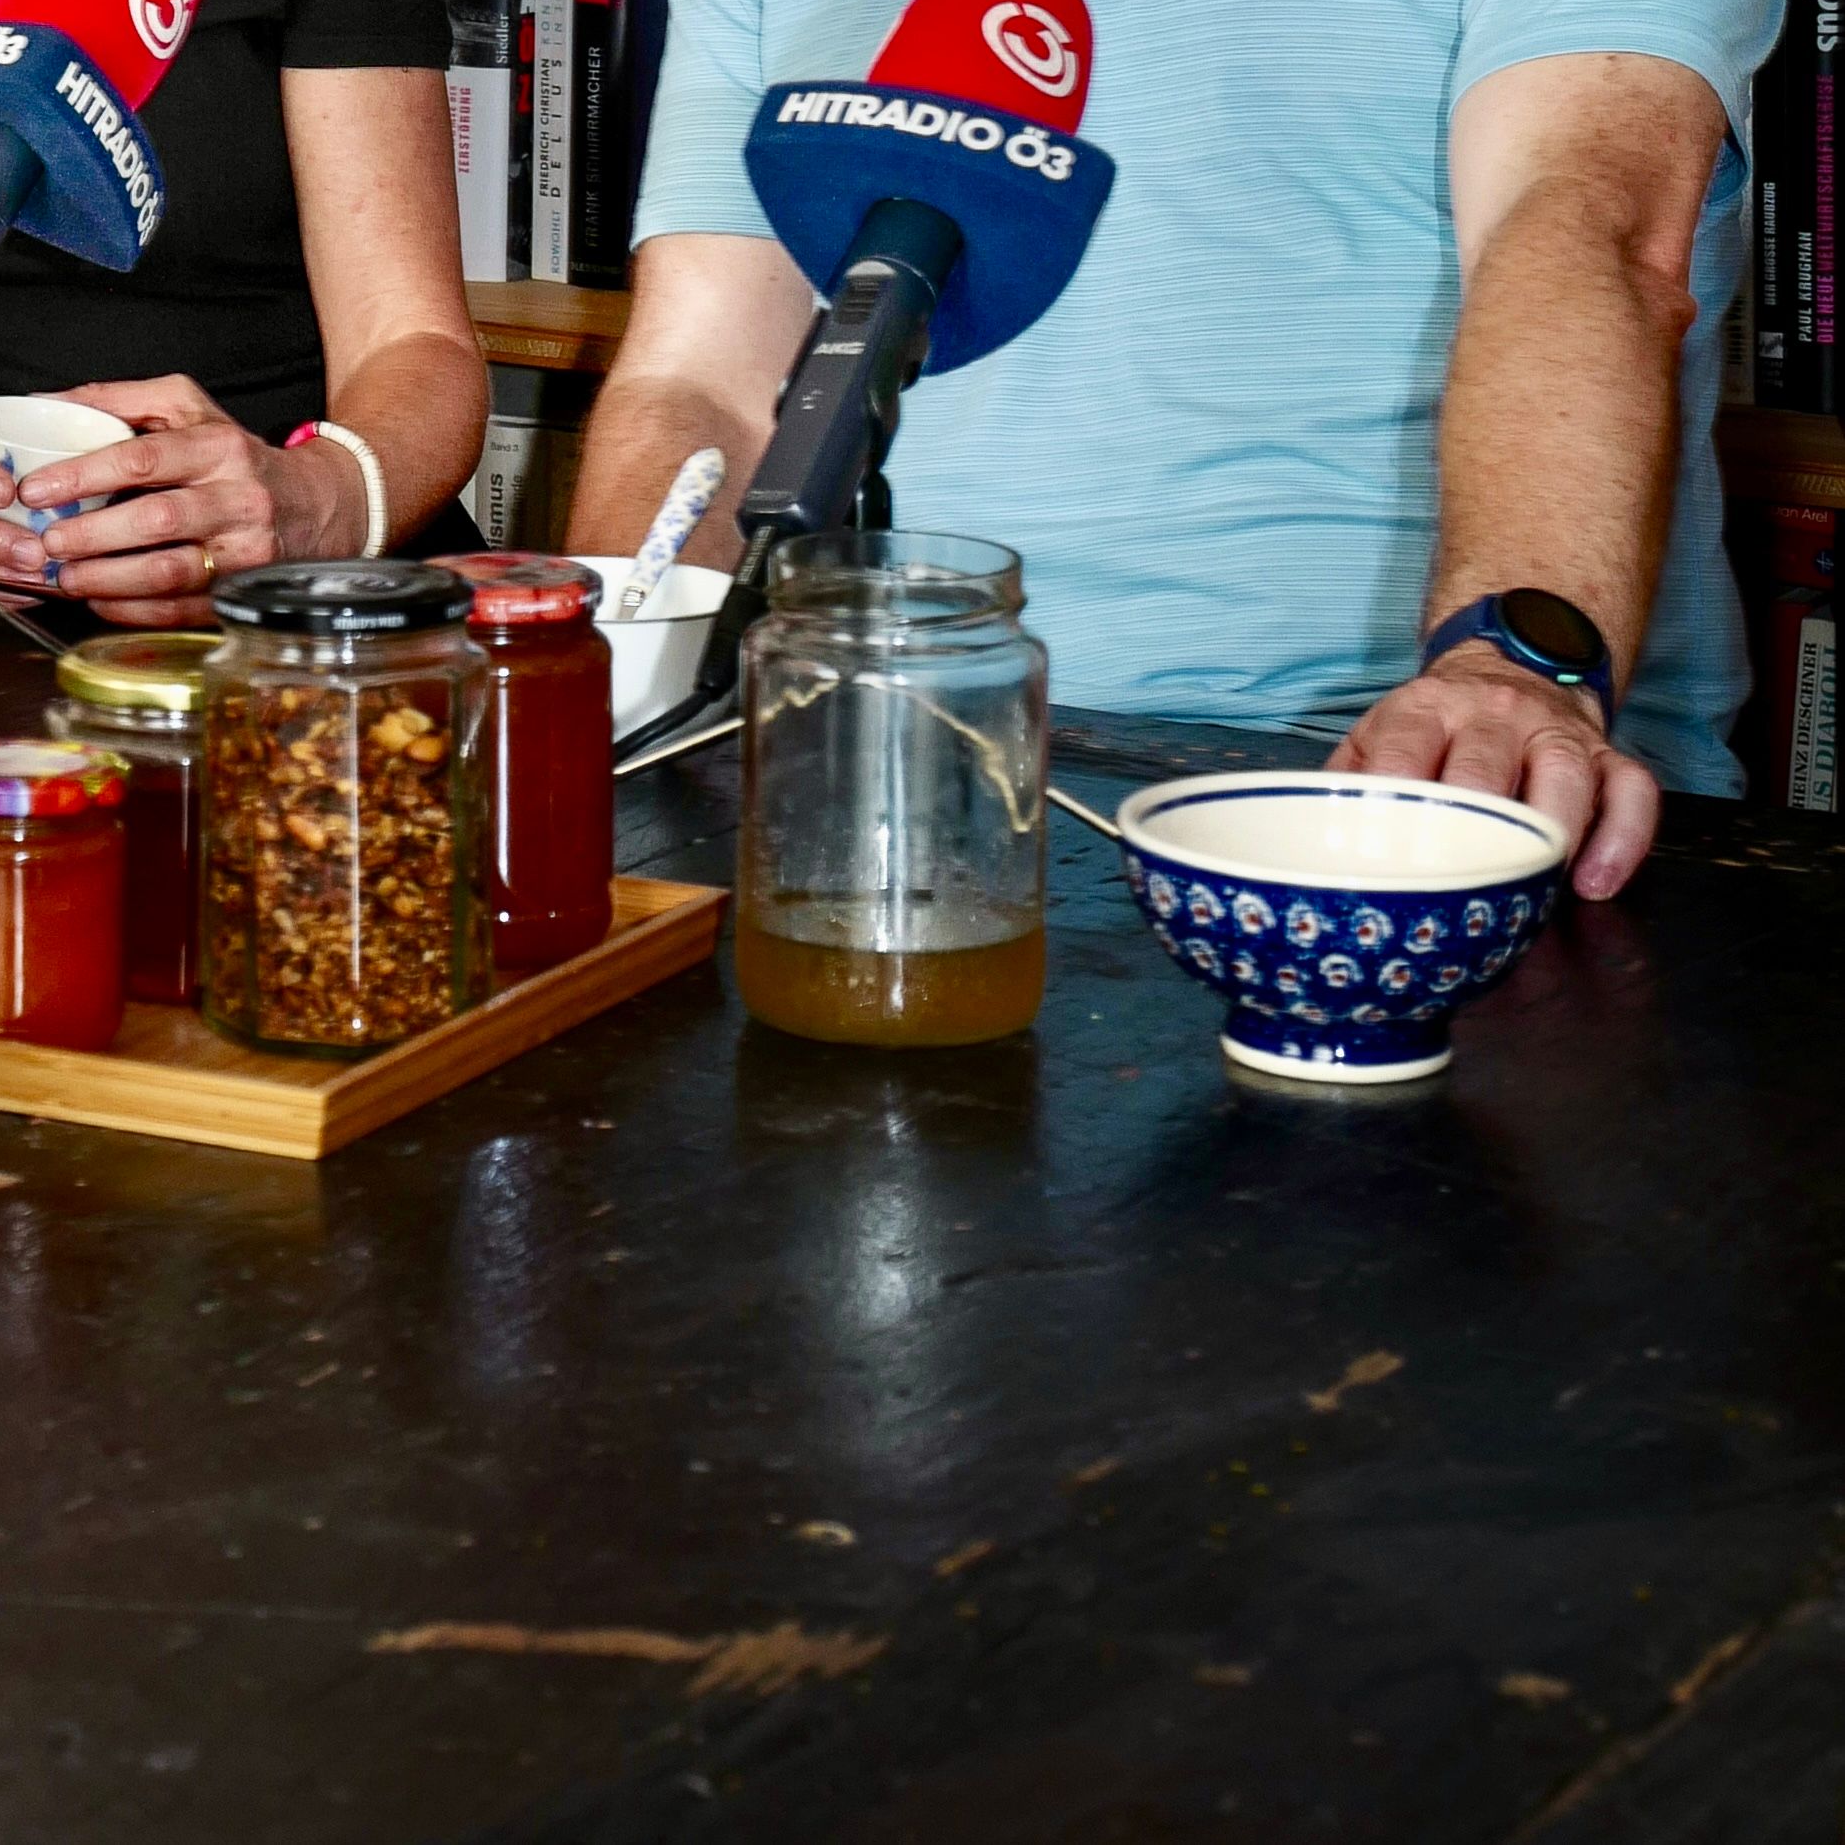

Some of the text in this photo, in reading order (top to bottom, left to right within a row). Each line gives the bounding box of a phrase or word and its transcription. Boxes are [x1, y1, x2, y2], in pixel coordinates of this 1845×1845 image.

[496, 13, 510, 64] Siedler
[55, 61, 155, 207] HITRADIO
[458, 87, 471, 174] ZERSTÖRUNG
[539, 58, 550, 197] FRIEDRICH CHRISTIAN
[585, 46, 602, 247] FRANK SCHIRRMACHER
[777, 91, 1077, 182] HITRADIO Ö3
[1764, 181, 1776, 305] DER GROSSE RAUBZUG
[1817, 73, 1834, 343] DIE NEUE WELTWIRTSCHAFTSKRISE
[1798, 231, 1813, 342] PAUL KRUGMAN
[1791, 643, 1817, 808] HEINZ DESCHNER
